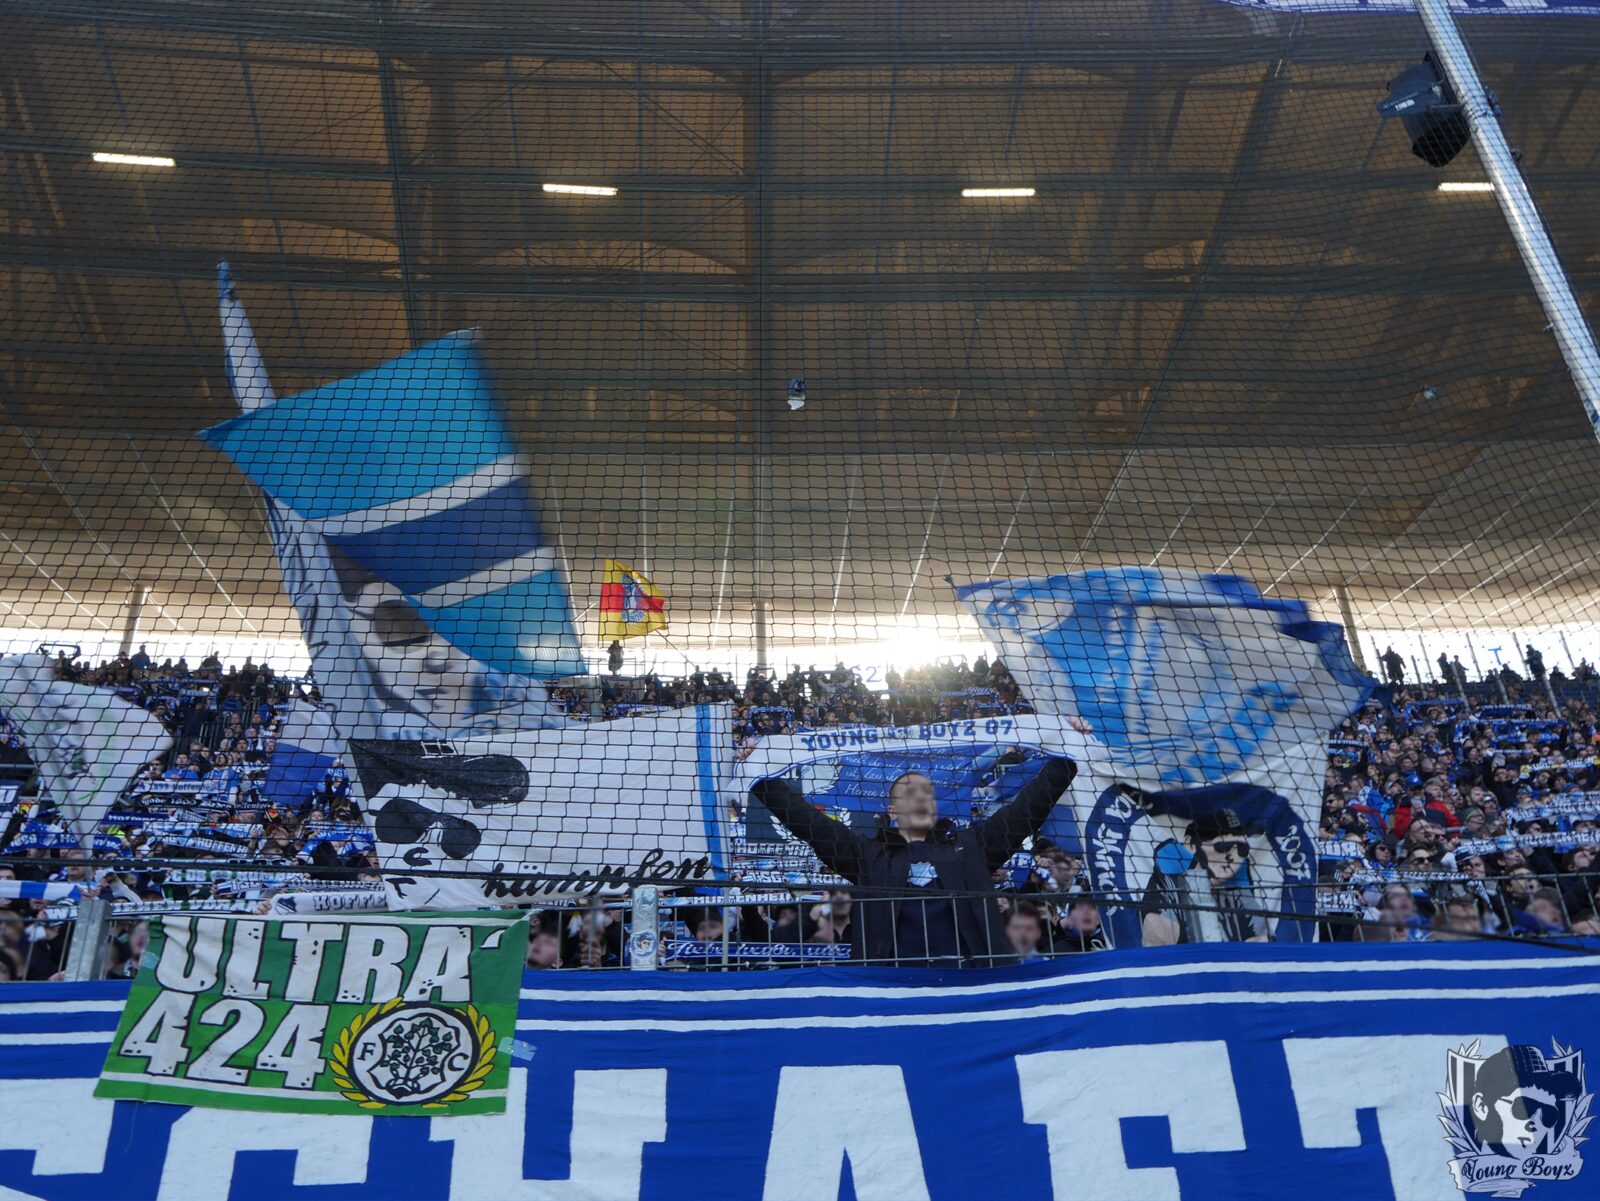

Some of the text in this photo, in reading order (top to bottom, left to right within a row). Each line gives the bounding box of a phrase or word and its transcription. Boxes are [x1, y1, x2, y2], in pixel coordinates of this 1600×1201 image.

[801, 720, 1013, 751] YOUNG BOYZ 07
[313, 894, 387, 911] HOFFE
[120, 990, 330, 1090] 424
[356, 1042, 470, 1072] F C
